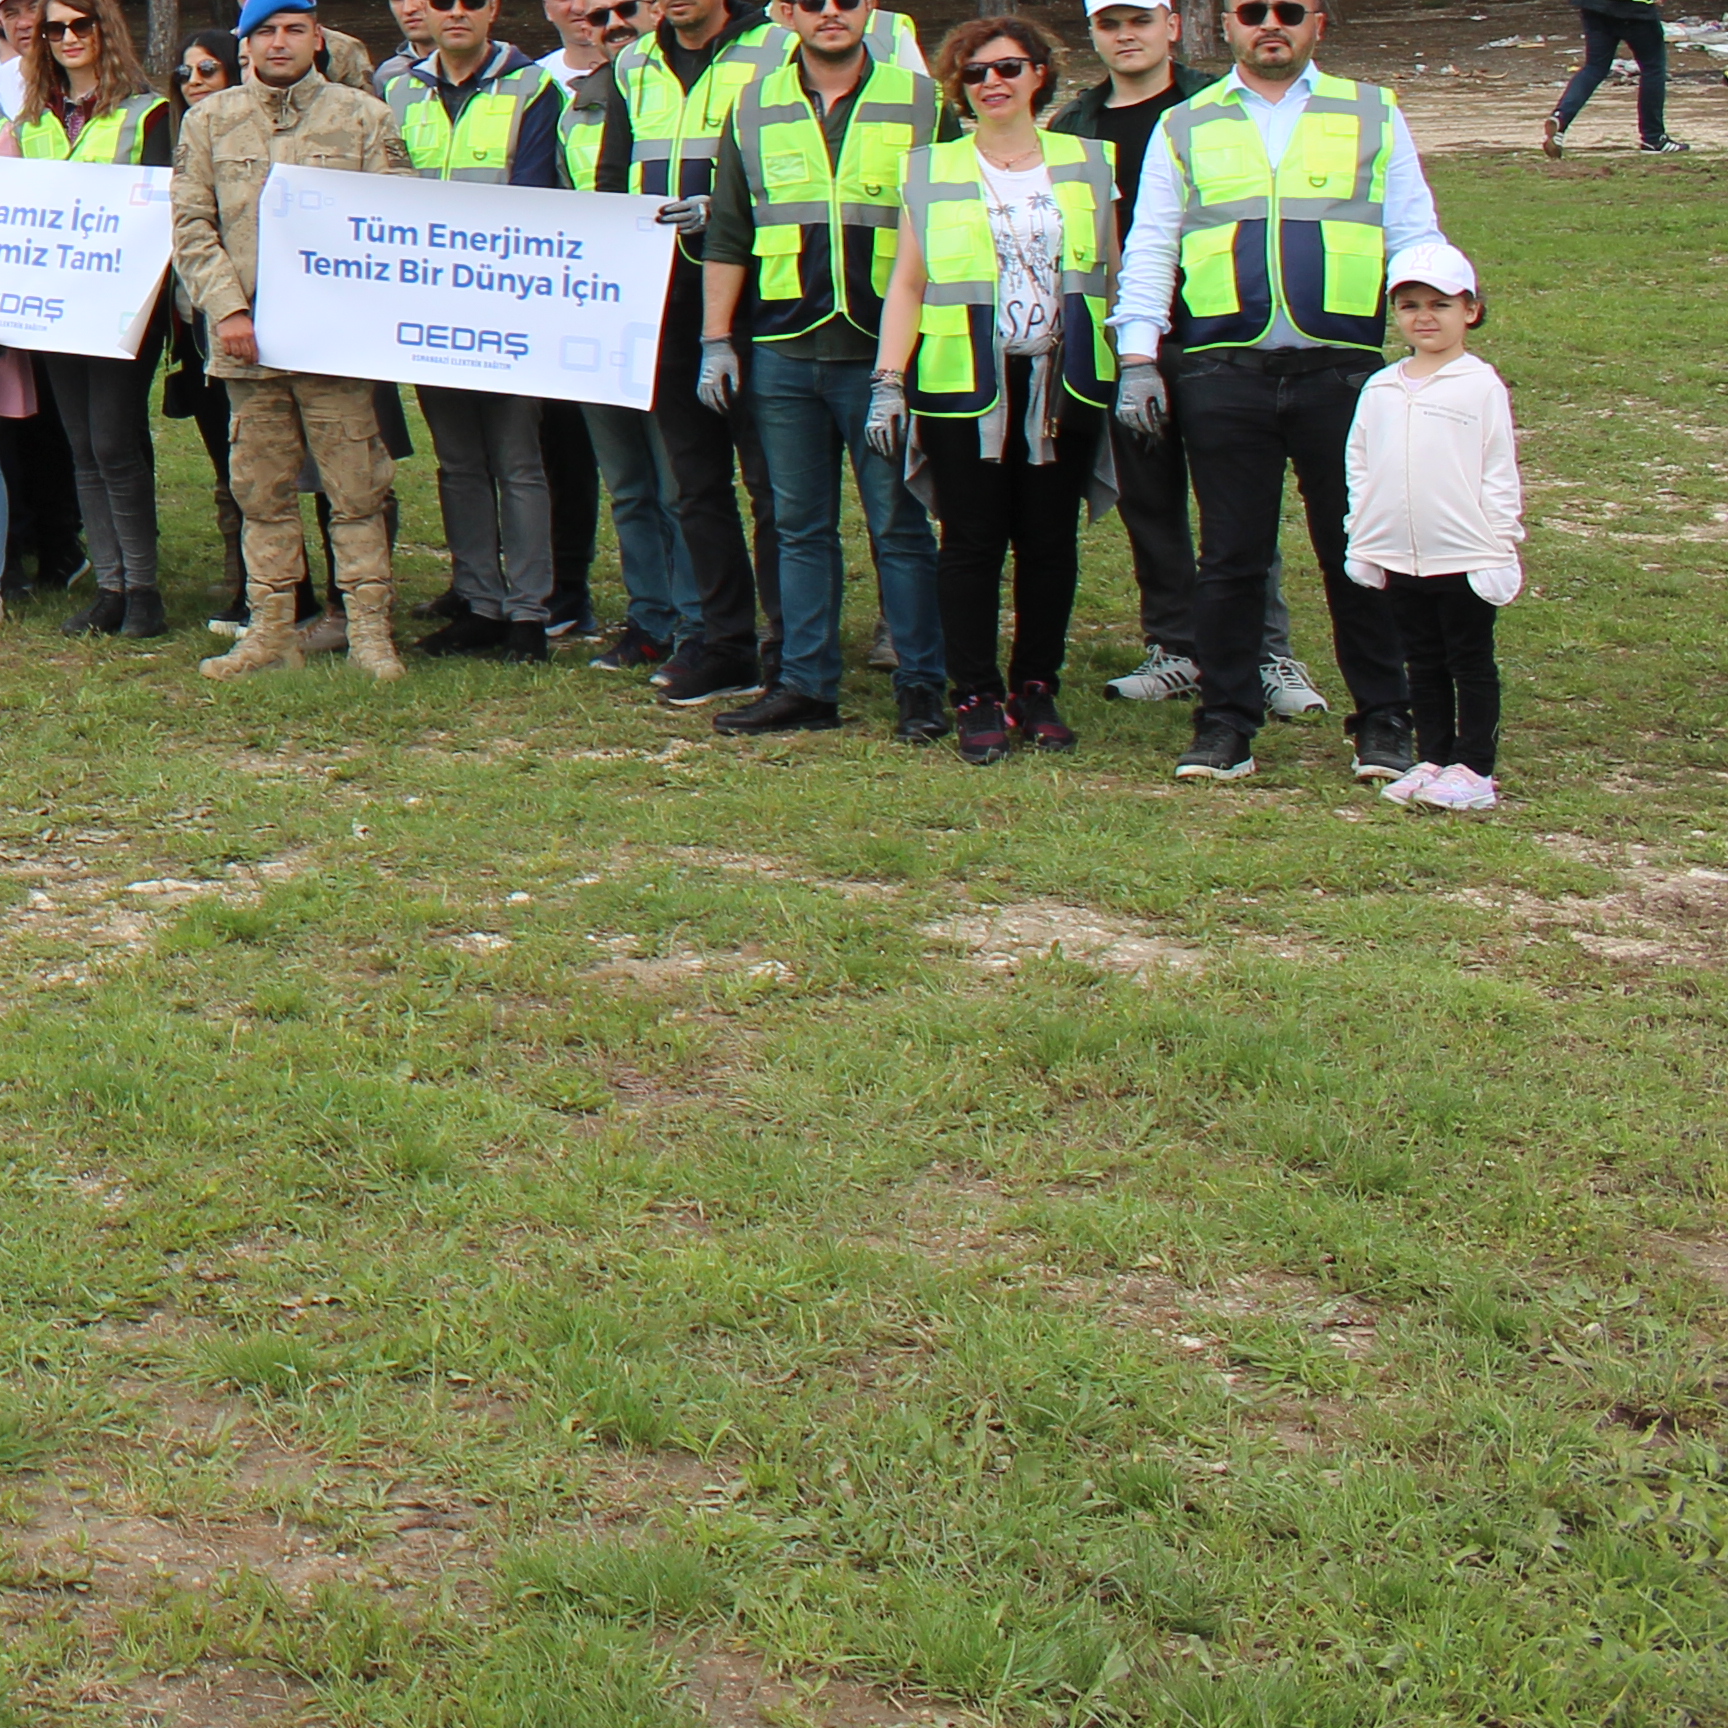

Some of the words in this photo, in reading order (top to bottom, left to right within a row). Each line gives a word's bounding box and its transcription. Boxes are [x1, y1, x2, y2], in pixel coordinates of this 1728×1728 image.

[71, 198, 120, 239] İçin
[348, 215, 418, 246] Tüm
[428, 222, 583, 260] Enerjimiz
[57, 243, 122, 273] Tam!
[299, 250, 390, 281] Temiz
[399, 257, 444, 286] Bir
[451, 262, 552, 300] Dünya
[562, 265, 620, 307] İçin
[396, 321, 529, 361] OEDAŞ
